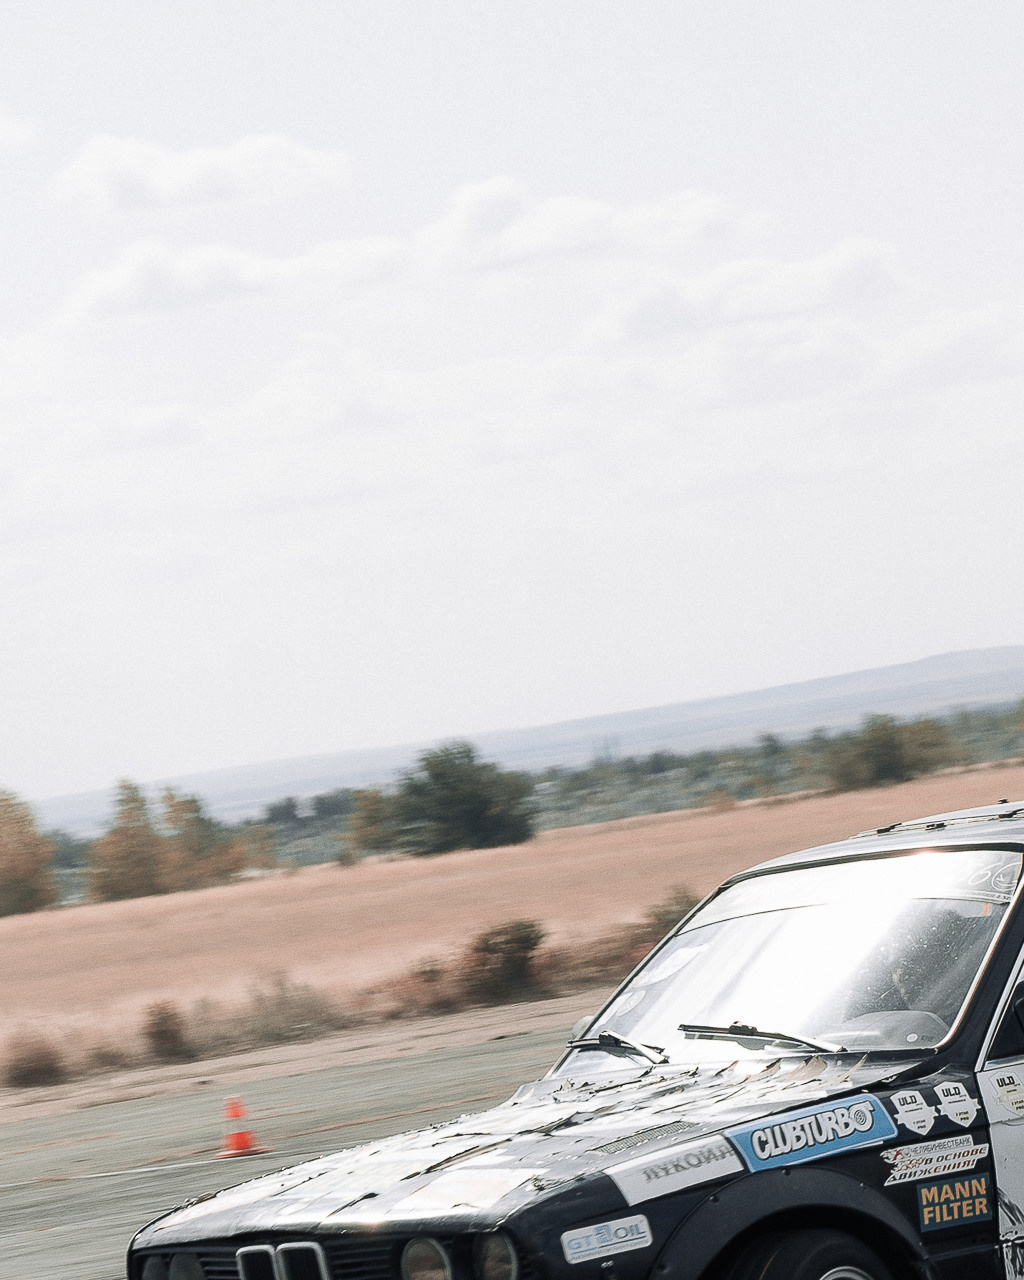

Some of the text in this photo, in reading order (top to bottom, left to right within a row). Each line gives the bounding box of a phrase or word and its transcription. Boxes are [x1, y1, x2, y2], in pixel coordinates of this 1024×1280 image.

[942, 1086, 961, 1098] ULD
[996, 1075, 1016, 1088] ULD
[898, 1095, 917, 1106] ULD
[752, 1101, 874, 1160] CLUBTURBO
[936, 1147, 987, 1163] ОСНОВЕ
[921, 1178, 987, 1205] MANN
[923, 1197, 988, 1225] FILTER
[567, 1234, 593, 1251] GT
[614, 1224, 647, 1240] OIL
